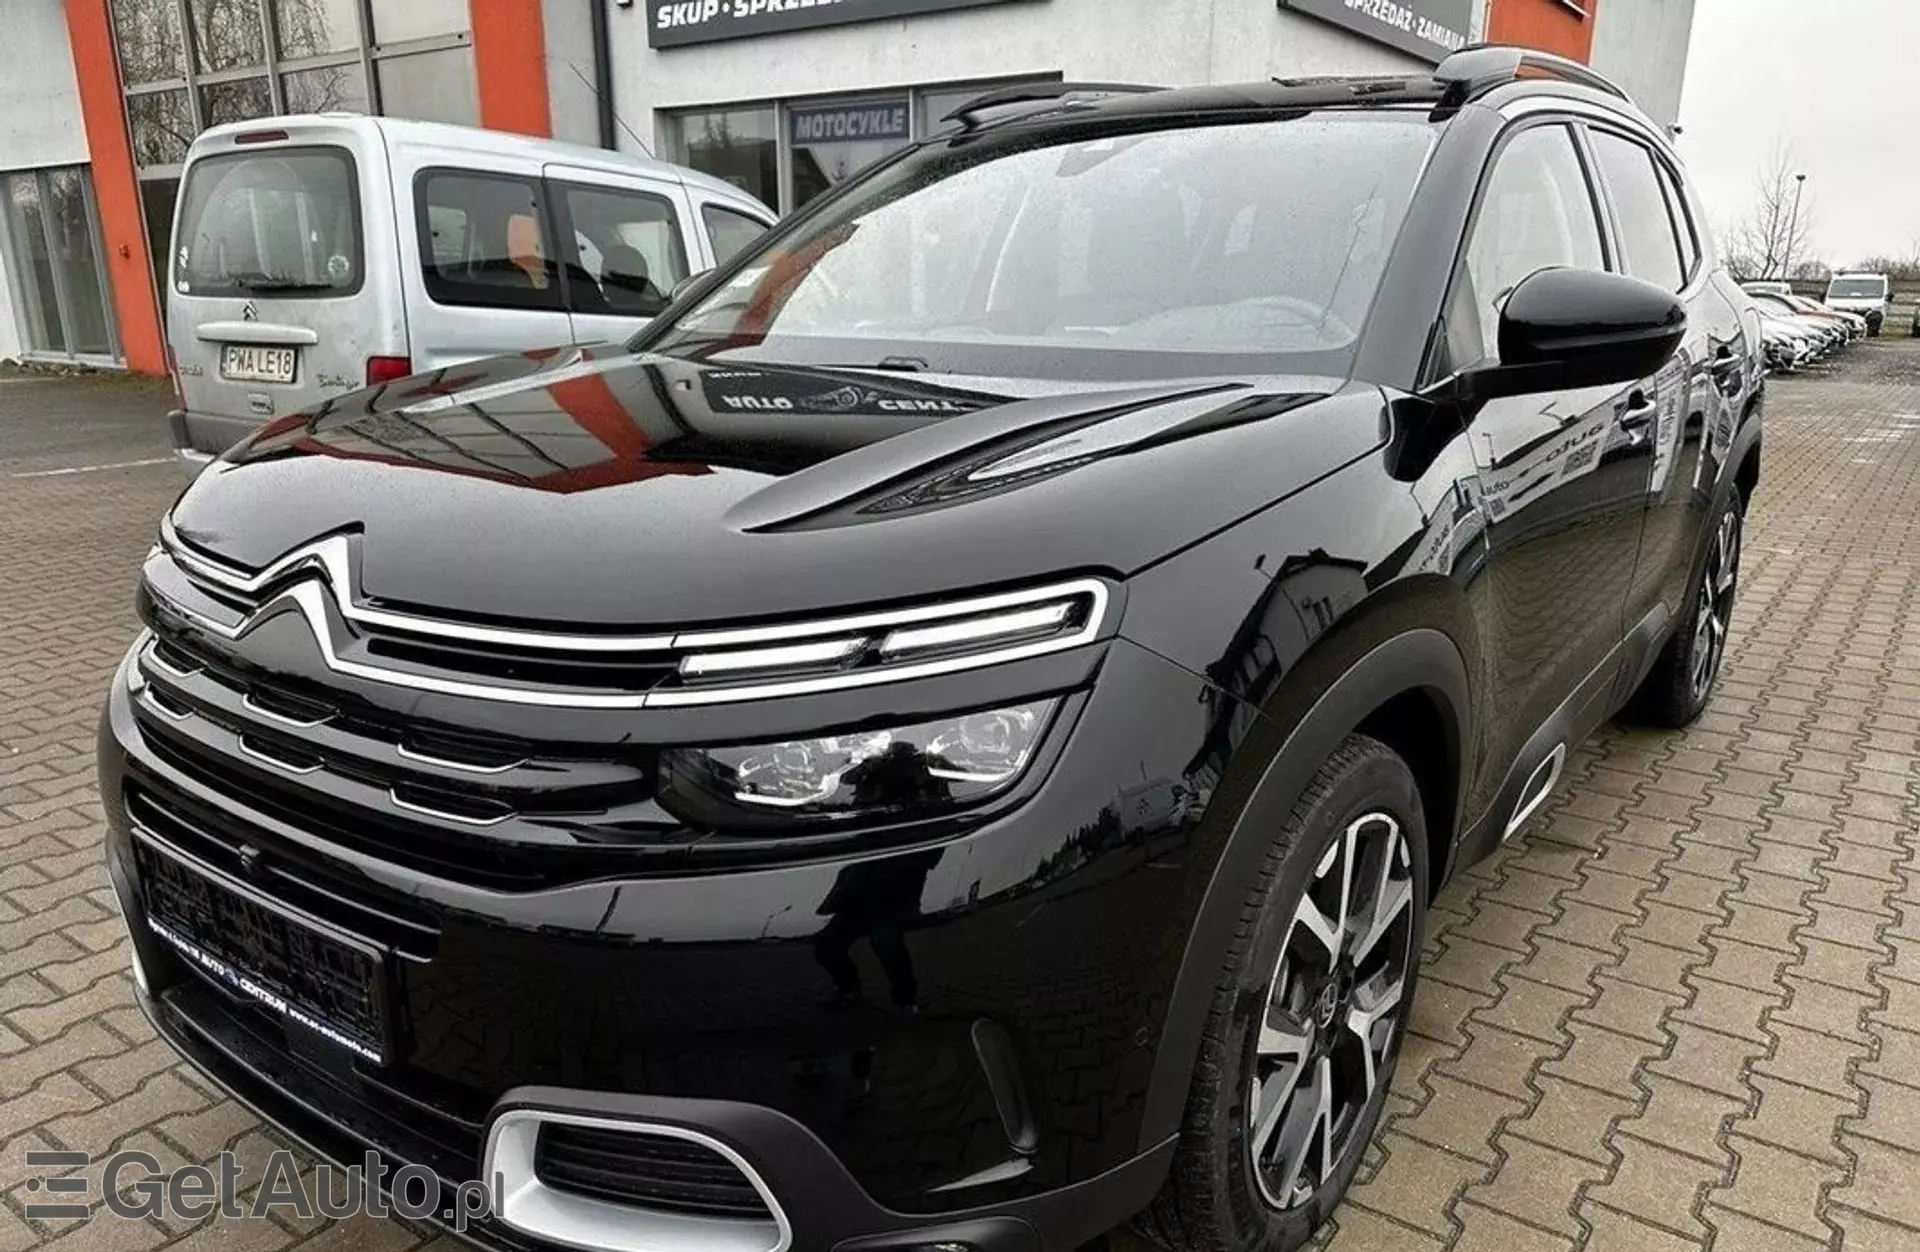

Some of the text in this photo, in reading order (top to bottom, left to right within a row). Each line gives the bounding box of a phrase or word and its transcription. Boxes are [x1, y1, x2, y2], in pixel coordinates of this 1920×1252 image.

[656, 1, 718, 29] SKUP
[796, 107, 905, 138] MOTOCYKLE
[229, 349, 255, 373] PWA
[257, 349, 293, 375] LE18
